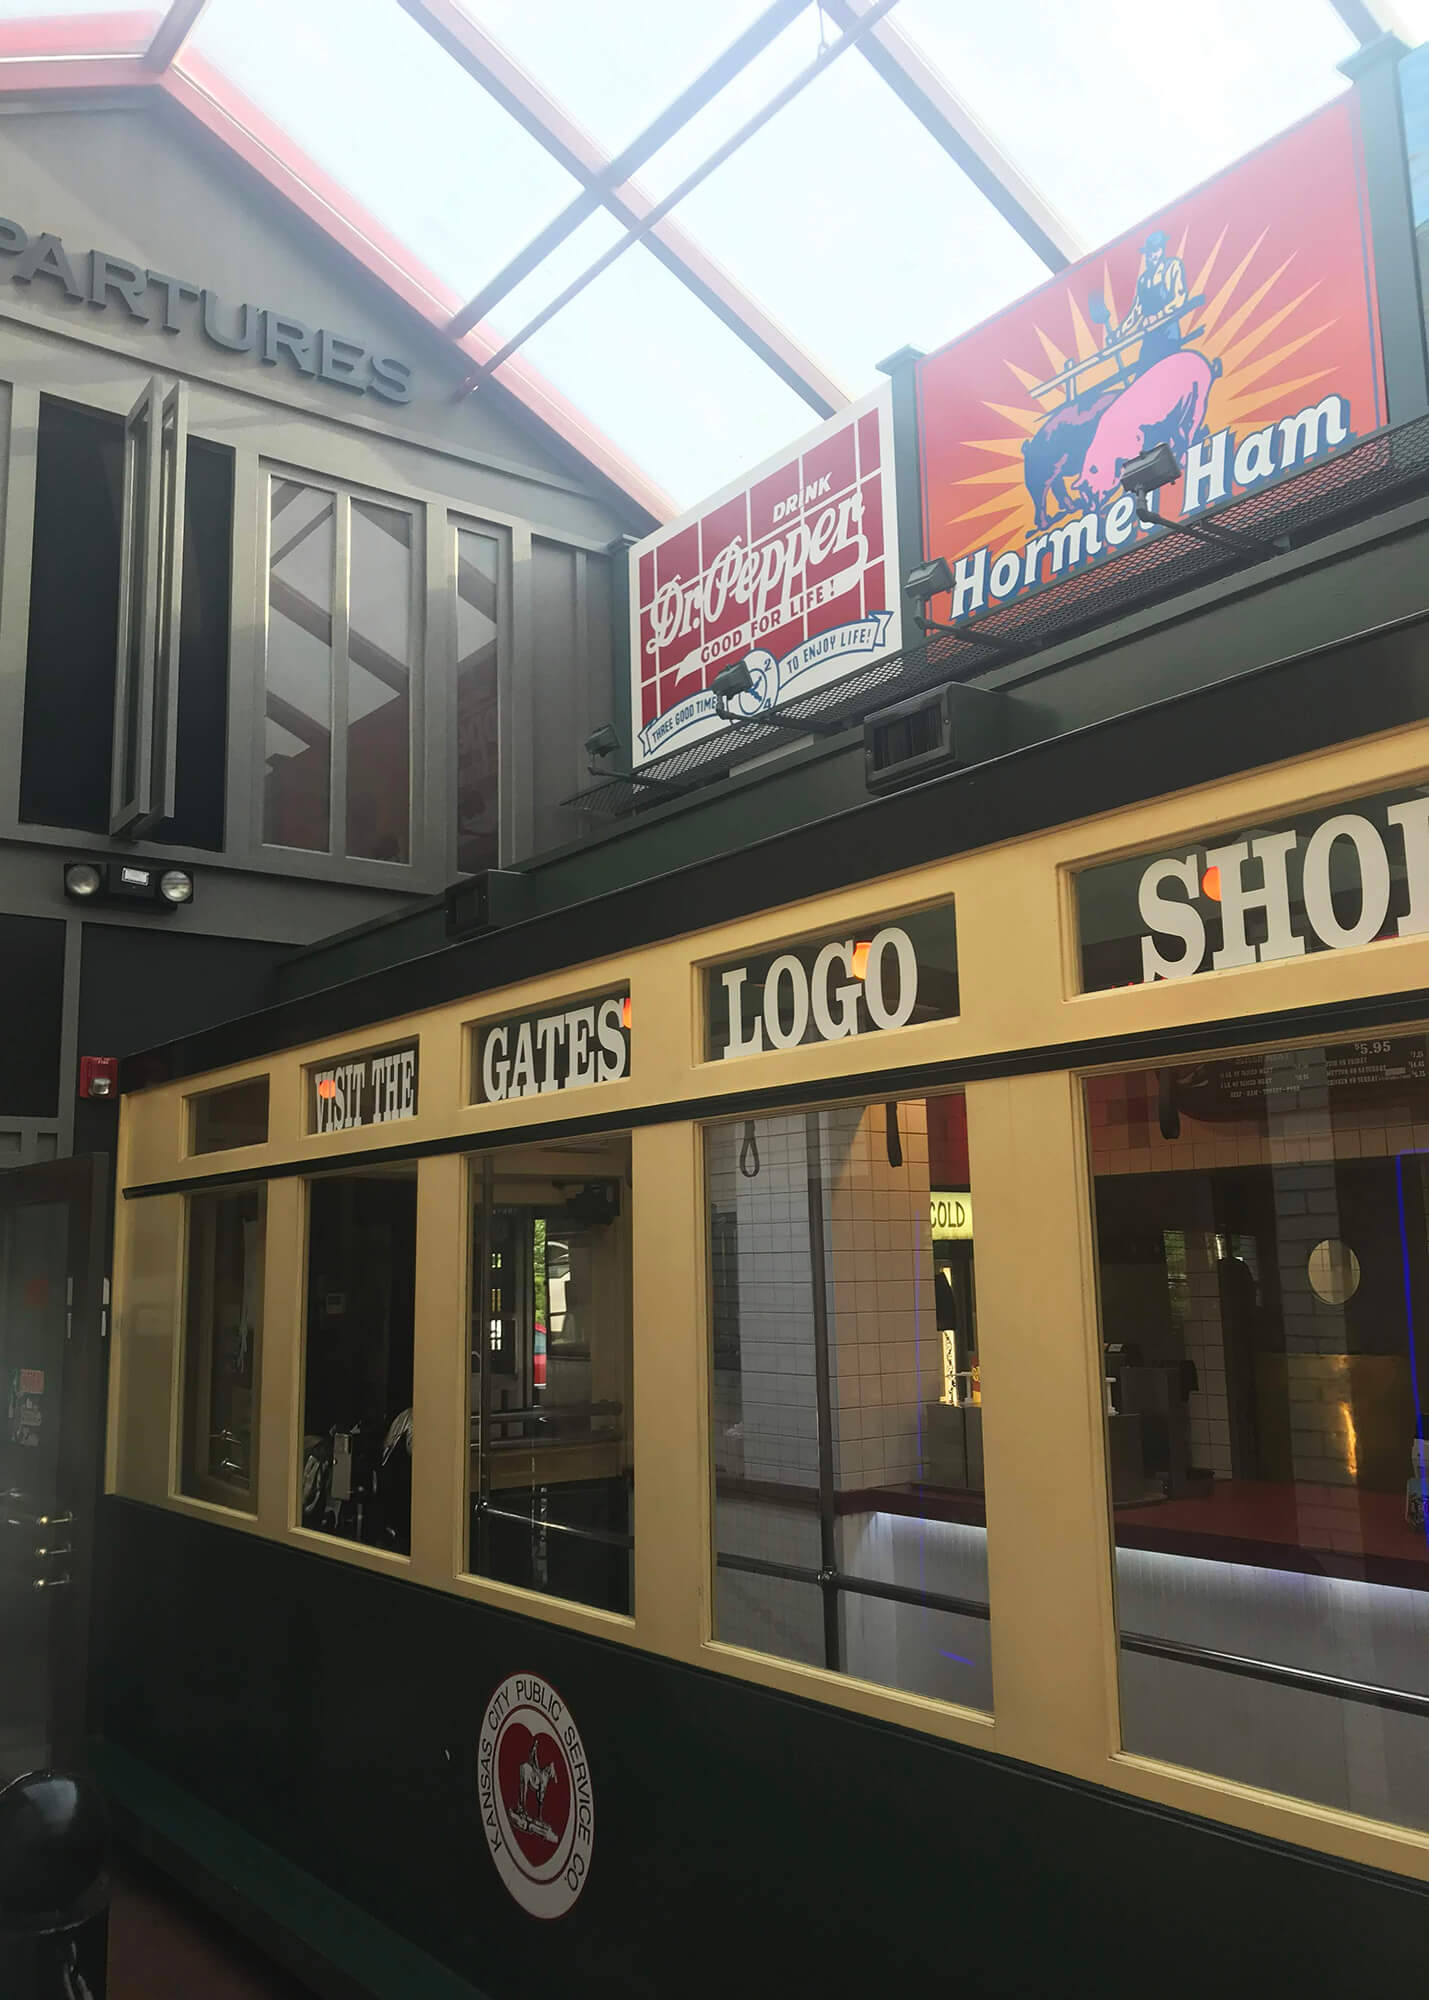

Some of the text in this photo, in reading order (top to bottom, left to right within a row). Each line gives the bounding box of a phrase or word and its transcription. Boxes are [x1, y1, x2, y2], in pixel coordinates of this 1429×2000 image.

[771, 471, 833, 524] DRINK
[1180, 393, 1348, 514] Ham
[646, 491, 869, 655] Dr. Pepper
[700, 578, 836, 664] GOOD FOR LIFE!
[651, 627, 872, 743] THREE GOOD TIME TO ENJOY LIFE!
[763, 658, 772, 672] 2
[314, 1062, 366, 1134] VISIT
[371, 1049, 415, 1124] THE
[482, 996, 629, 1103] GATES
[721, 926, 918, 1060] LOGO
[930, 1200, 966, 1228] COLD
[488, 1685, 510, 1732] CITY
[515, 1679, 563, 1722] PUBLIC
[480, 1738, 503, 1853] KANSAS
[564, 1725, 592, 1846] SERVICE
